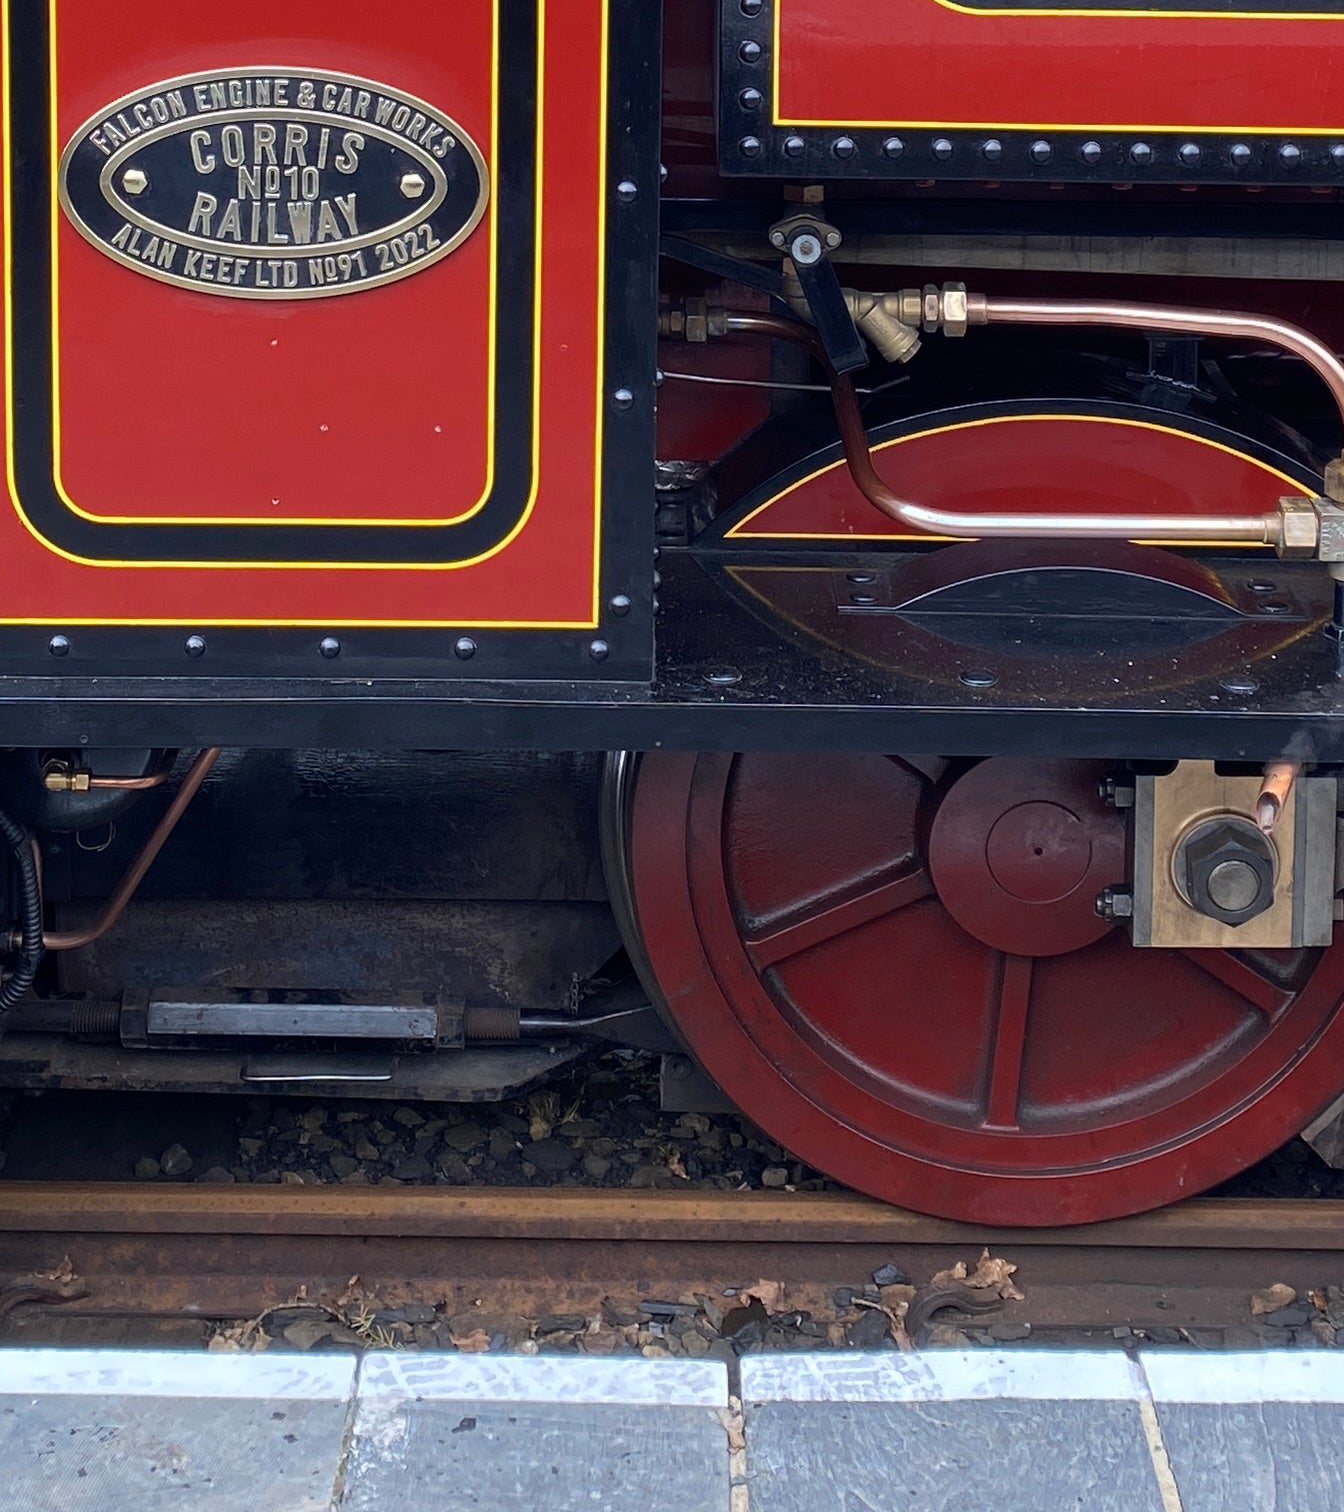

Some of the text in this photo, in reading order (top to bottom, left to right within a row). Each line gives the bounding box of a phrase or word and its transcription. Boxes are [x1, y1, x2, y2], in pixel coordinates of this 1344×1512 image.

[89, 79, 456, 159] FALCON ENGINE & CAR WORKS
[190, 123, 365, 175] CORRIS
[188, 191, 359, 245] RAILWAY
[111, 222, 178, 270] ALAN
[183, 249, 250, 285] KEEF
[255, 259, 299, 288] LTD
[374, 223, 441, 272] 2022
